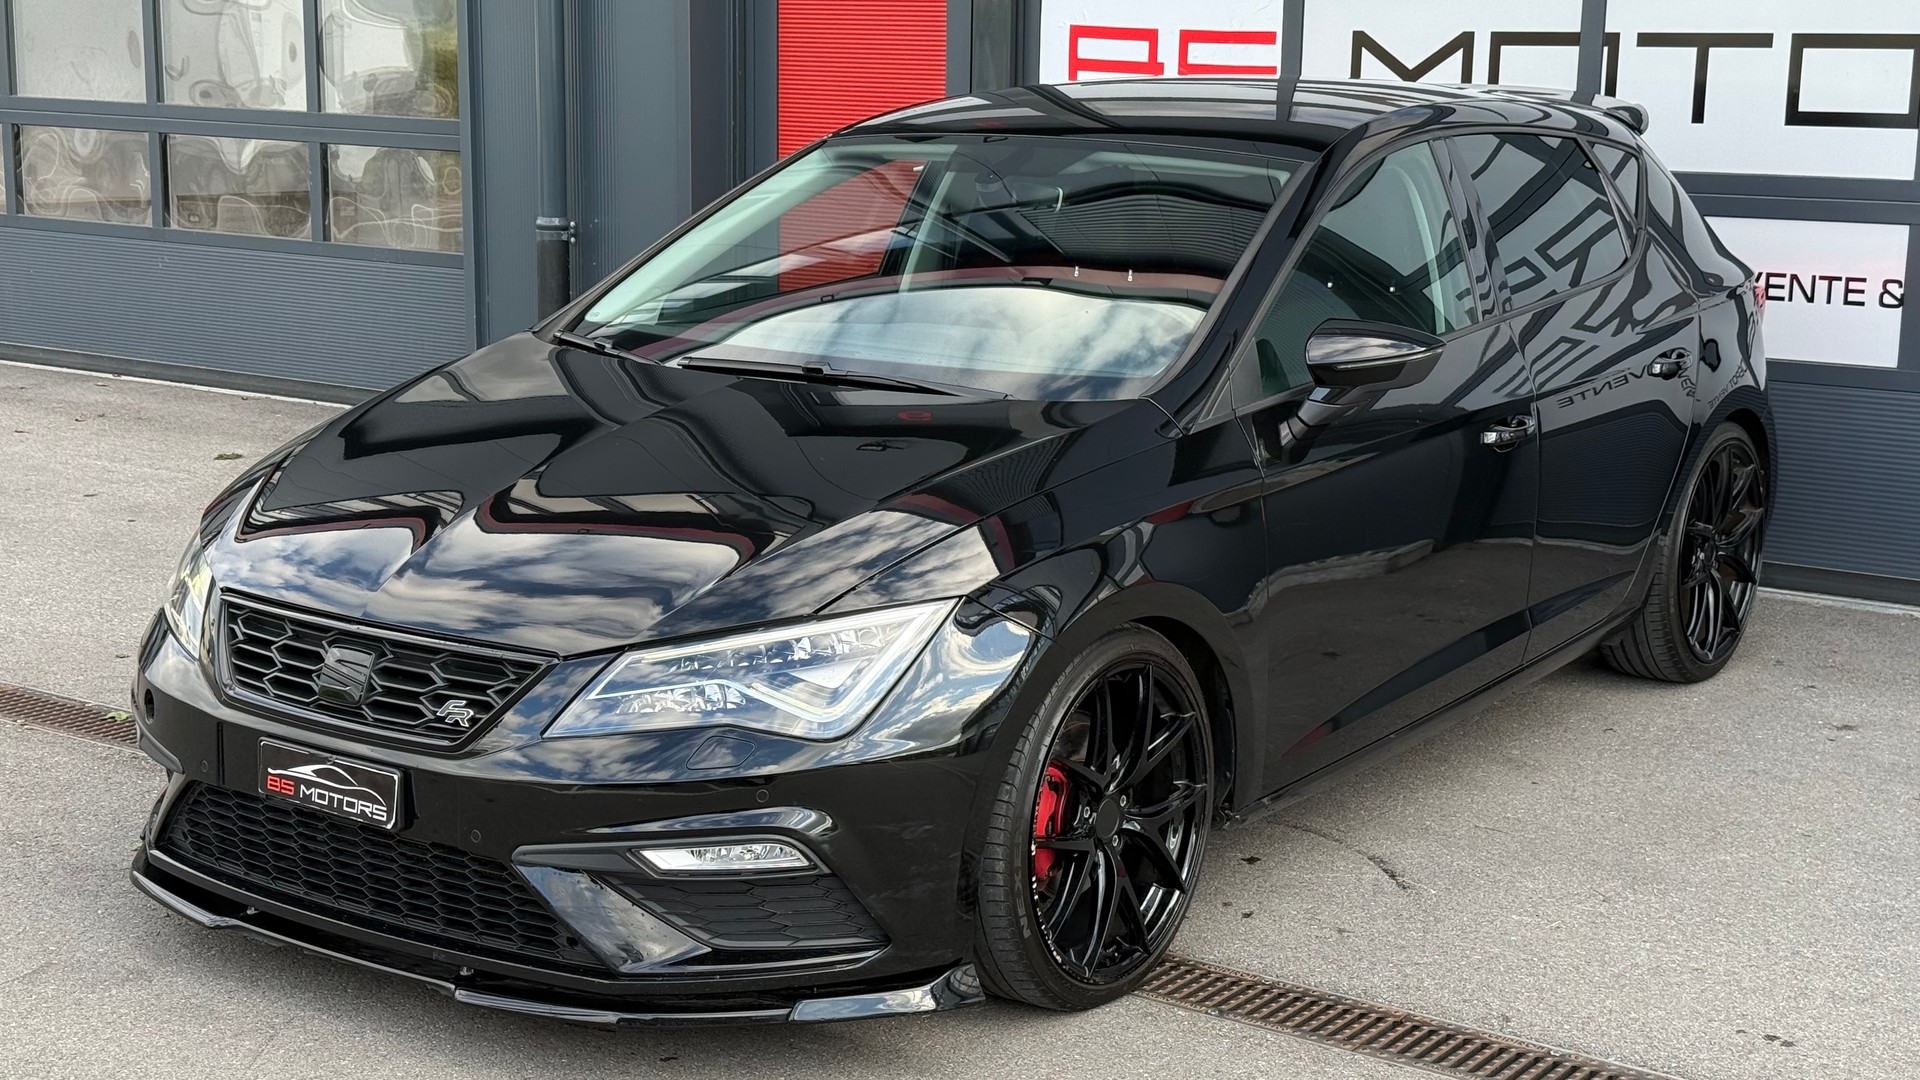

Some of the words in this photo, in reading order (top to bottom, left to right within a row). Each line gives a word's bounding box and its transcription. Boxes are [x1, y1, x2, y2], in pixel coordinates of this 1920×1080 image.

[1755, 272, 1867, 306] ENTE
[436, 699, 474, 727] FR
[267, 775, 294, 795] BS
[300, 784, 387, 821] MOTORS
